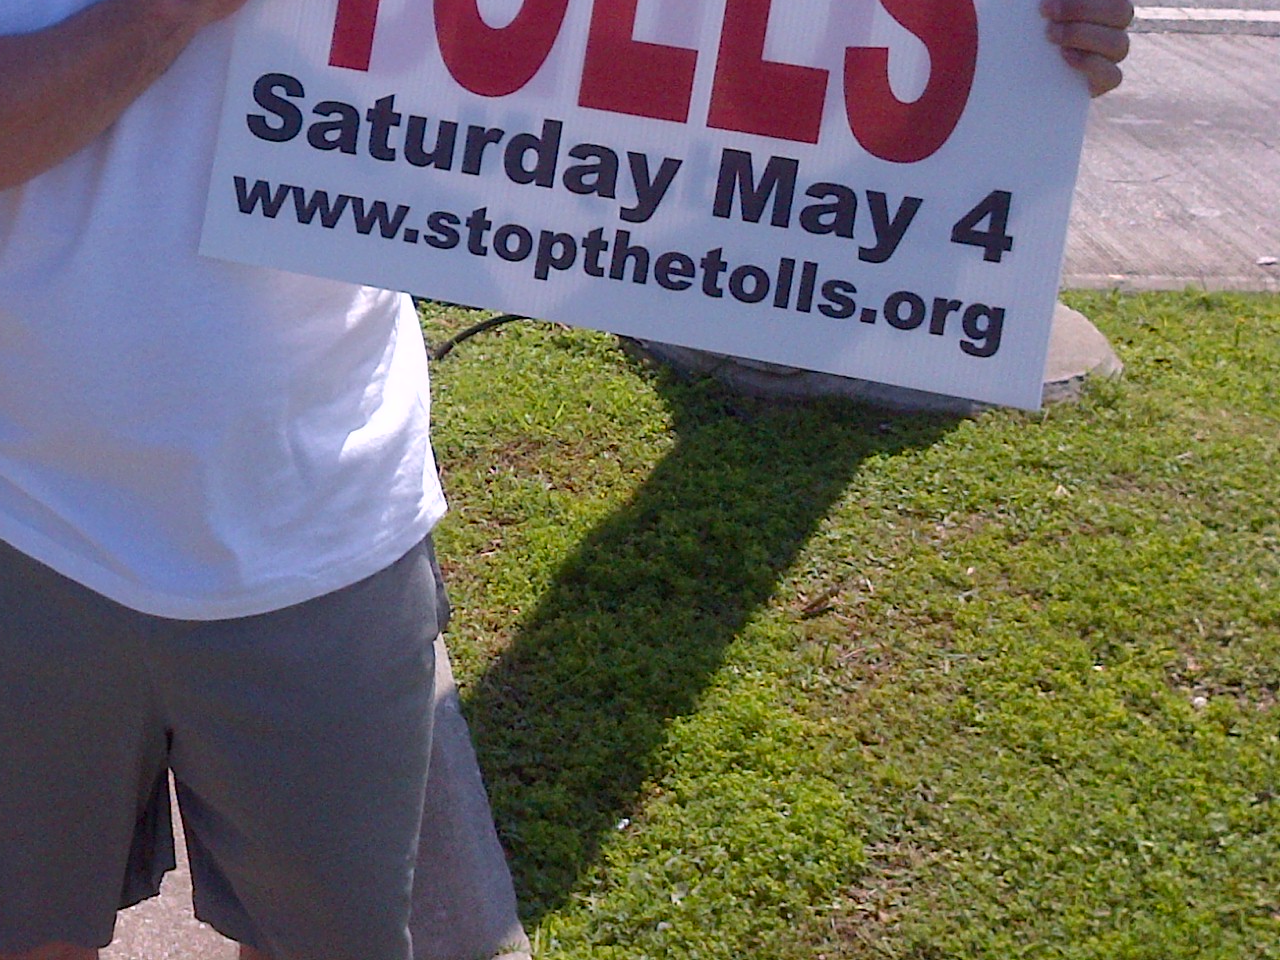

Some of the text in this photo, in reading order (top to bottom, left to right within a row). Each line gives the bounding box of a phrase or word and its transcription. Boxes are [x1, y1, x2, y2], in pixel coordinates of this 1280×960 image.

[246, 72, 1014, 264] Saturday May 4
[233, 175, 1007, 359] www.stopthetolls.org
